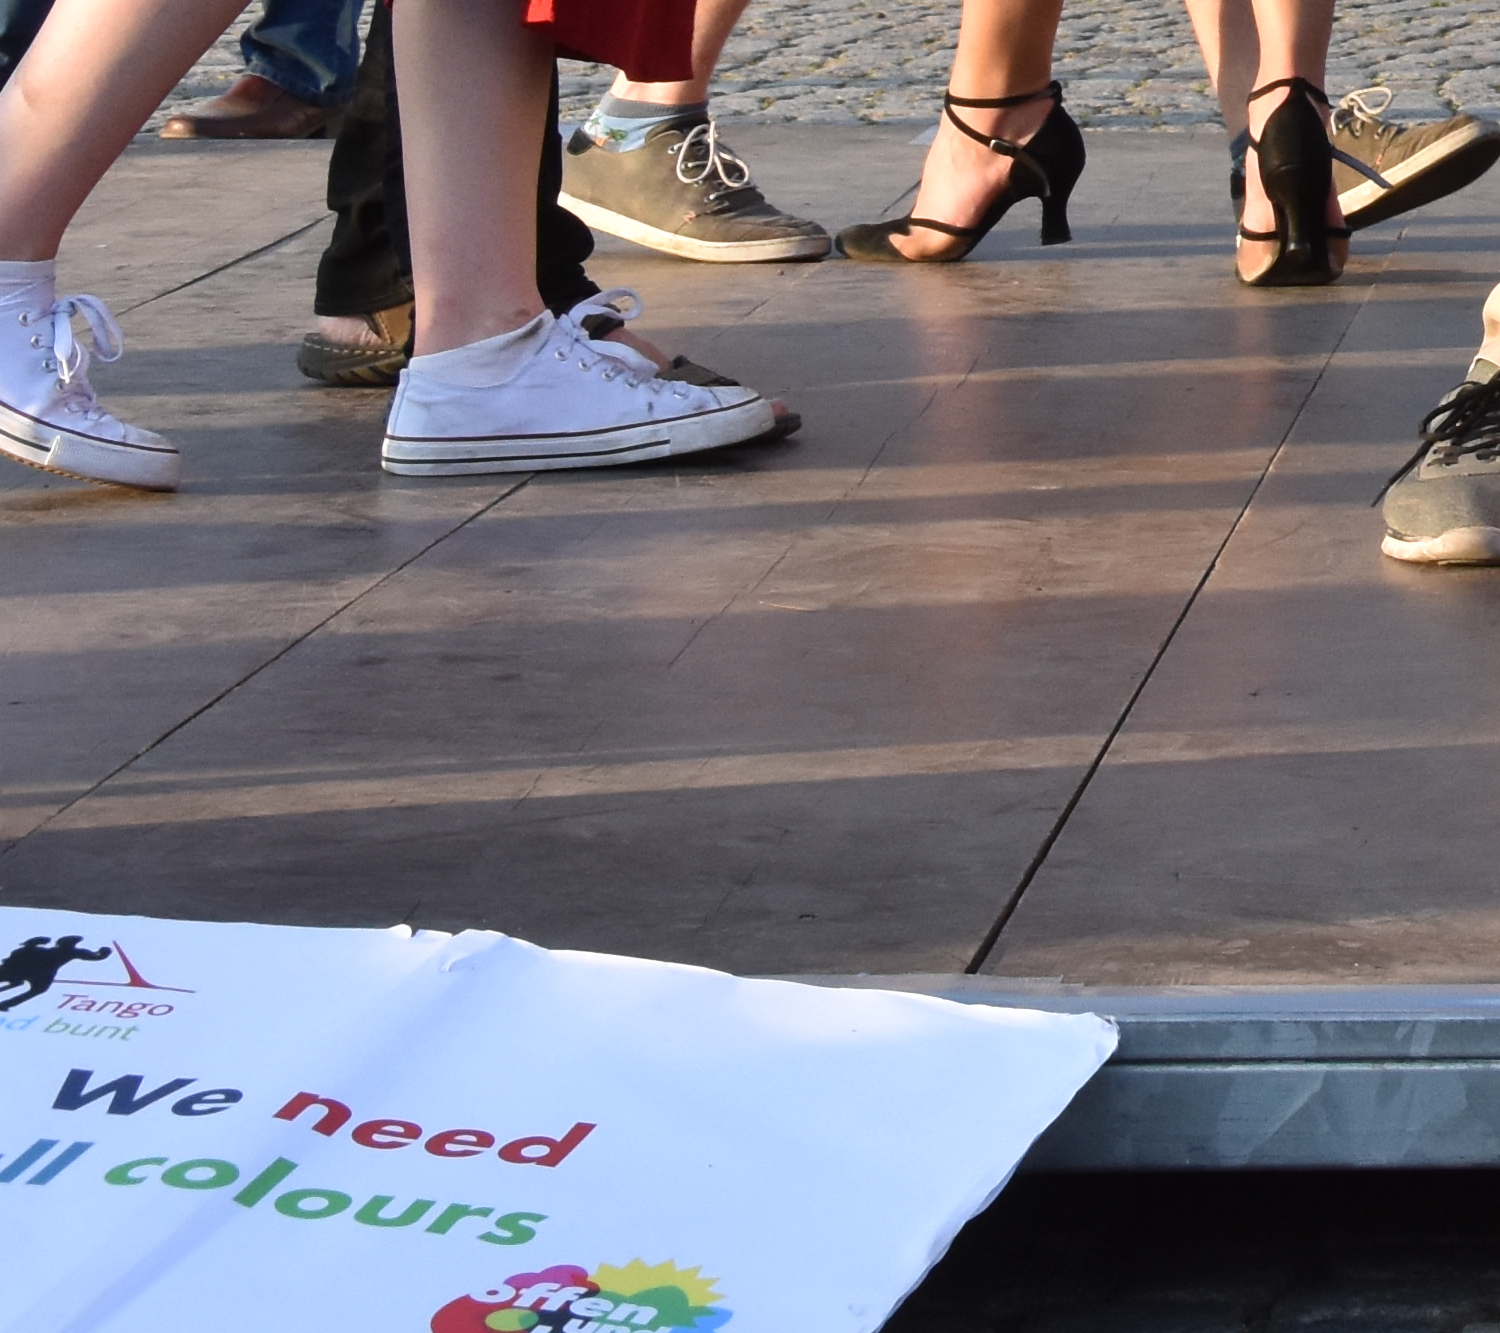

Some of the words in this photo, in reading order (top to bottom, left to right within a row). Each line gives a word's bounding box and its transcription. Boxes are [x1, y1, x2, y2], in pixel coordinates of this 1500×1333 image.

[57, 994, 174, 1018] Tango
[43, 1017, 140, 1041] bunt
[52, 1068, 243, 1117] We
[272, 1090, 598, 1168] need
[0, 1137, 95, 1186] ll
[104, 1156, 549, 1247] colours
[468, 1281, 659, 1325] offen
